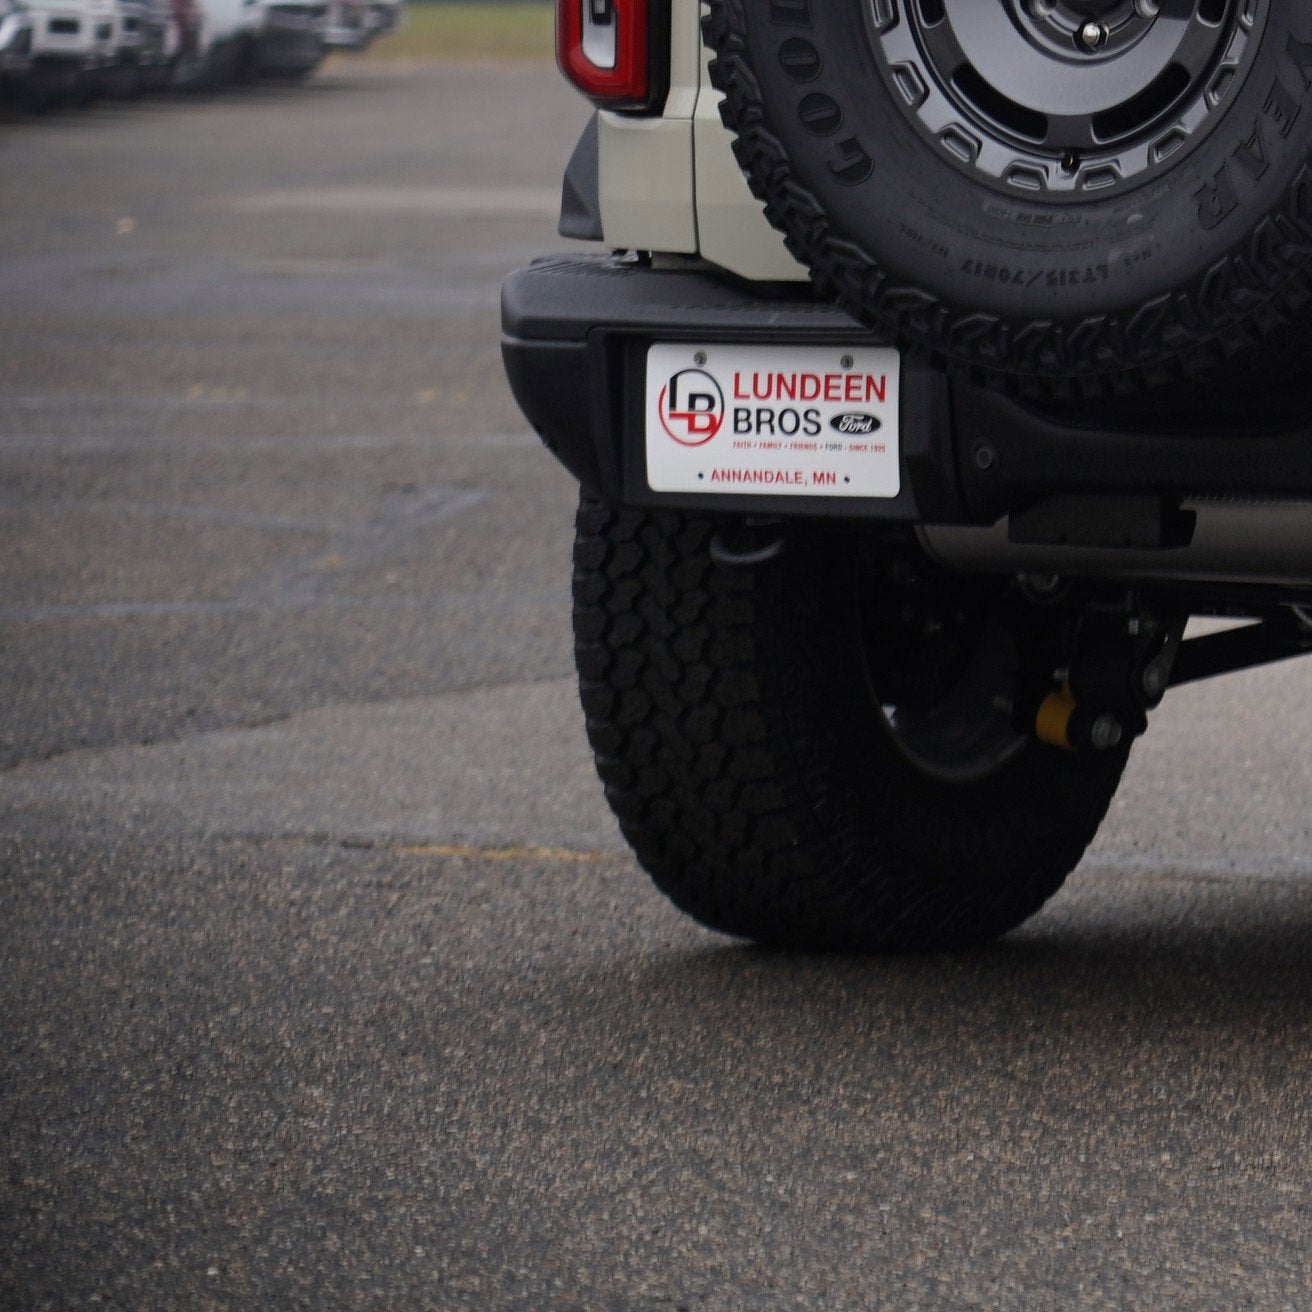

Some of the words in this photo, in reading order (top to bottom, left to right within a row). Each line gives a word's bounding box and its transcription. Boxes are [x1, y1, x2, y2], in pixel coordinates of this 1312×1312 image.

[733, 371, 887, 404] LUNDEEN
[732, 407, 822, 437] BROS
[732, 441, 751, 449] FAITH
[759, 441, 782, 450] FAMILY
[789, 442, 818, 451] FRIENDS
[825, 443, 843, 451] FORD
[710, 467, 808, 486] ANNANDALE,
[812, 471, 836, 485] MN
